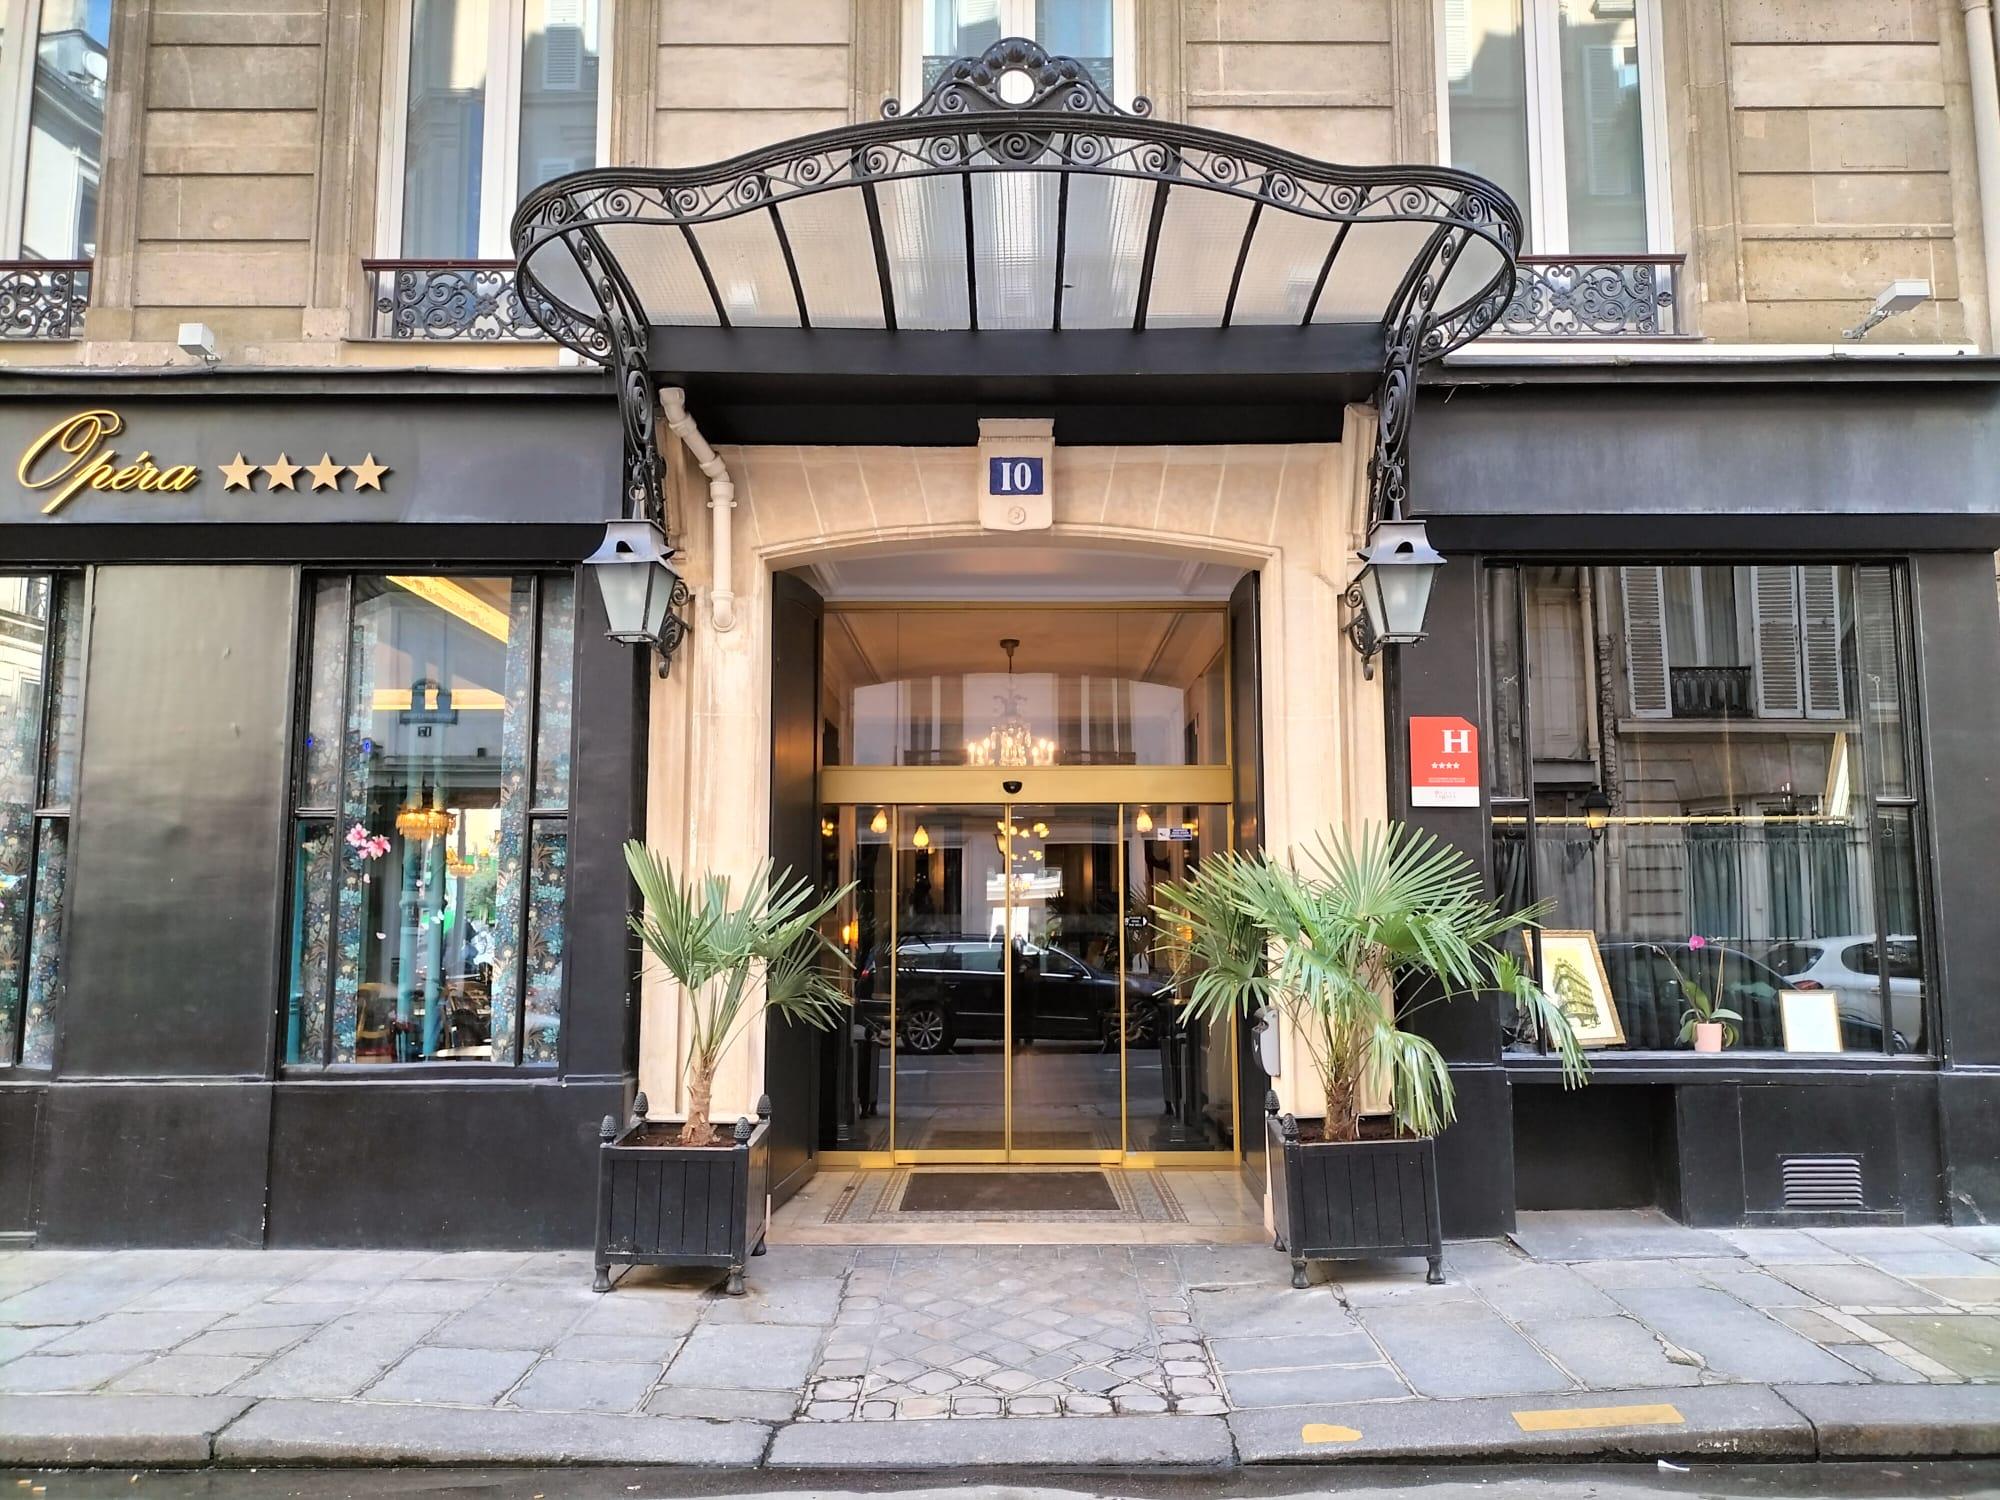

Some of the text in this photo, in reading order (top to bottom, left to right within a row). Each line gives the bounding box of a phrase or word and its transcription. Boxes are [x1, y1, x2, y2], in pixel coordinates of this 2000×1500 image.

[18, 409, 200, 514] Opéra
[1001, 462, 1032, 491] 10
[1441, 729, 1472, 754] H
